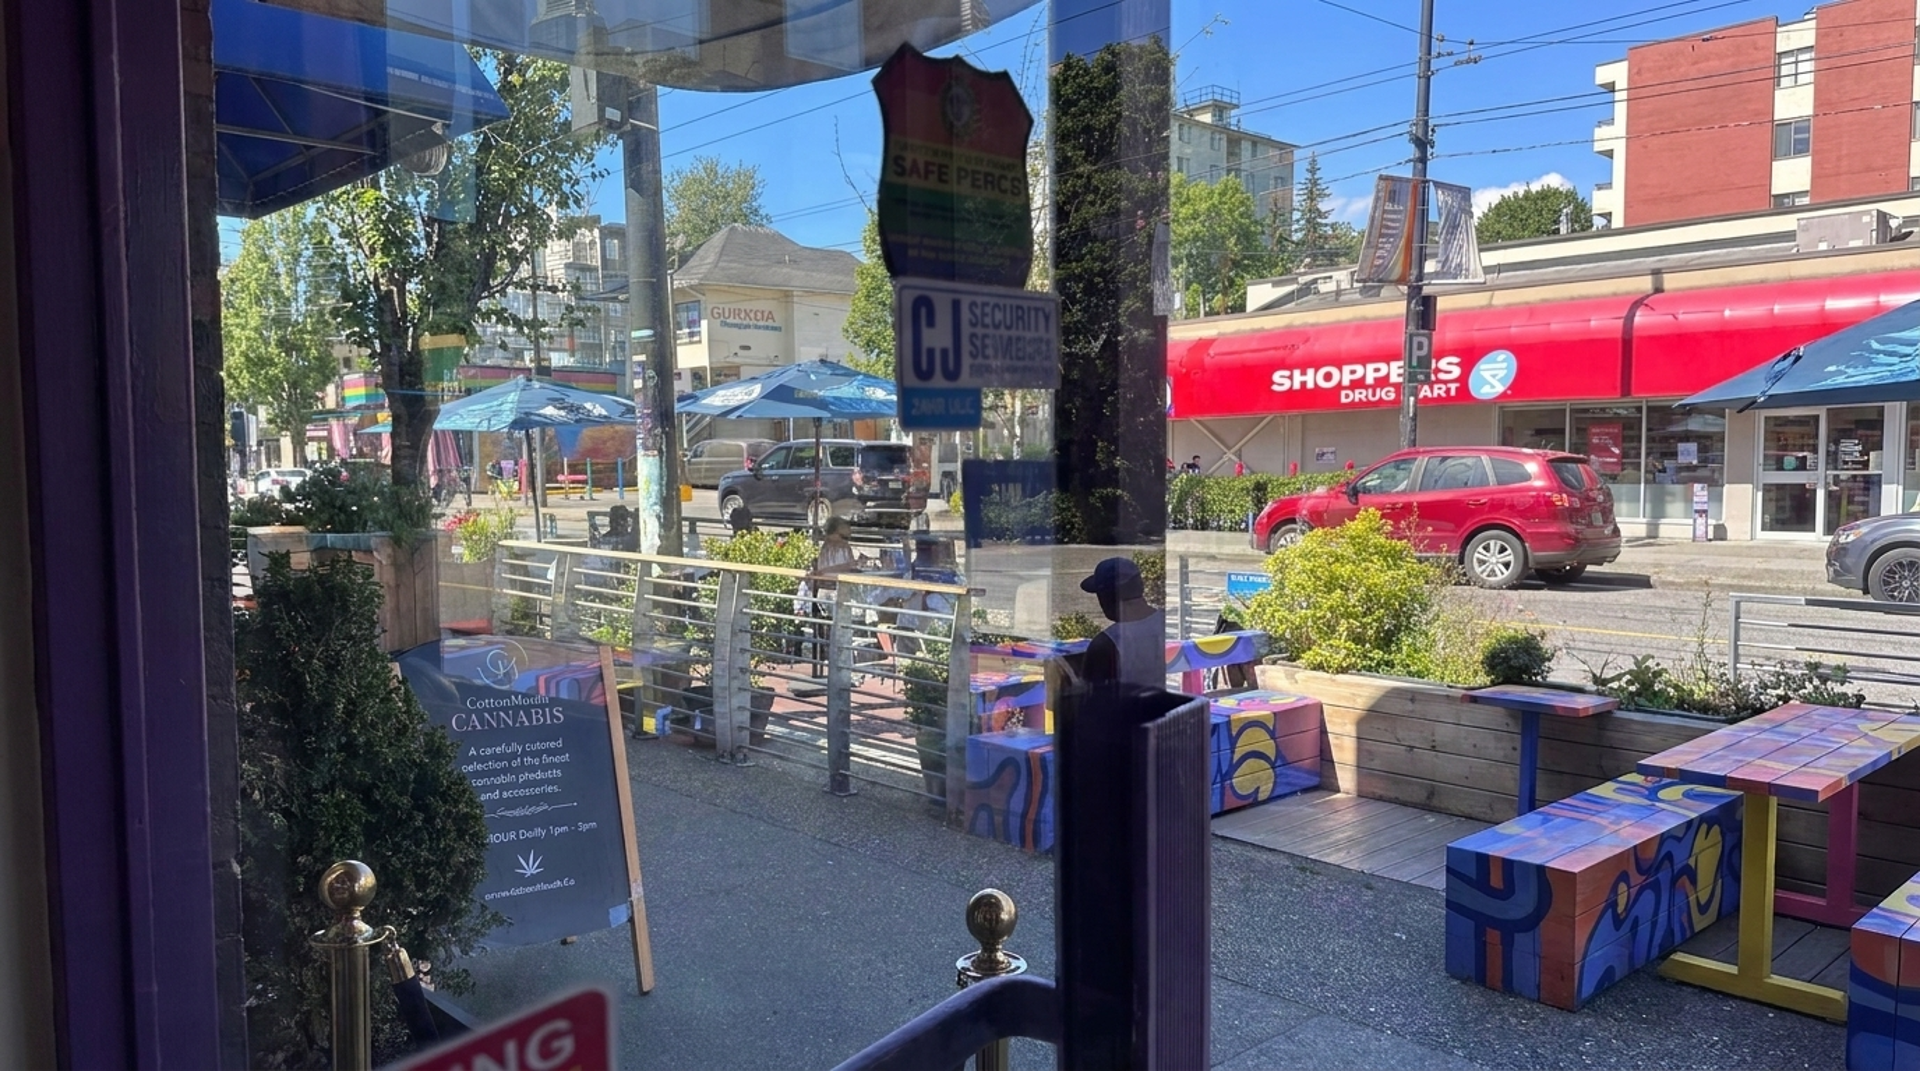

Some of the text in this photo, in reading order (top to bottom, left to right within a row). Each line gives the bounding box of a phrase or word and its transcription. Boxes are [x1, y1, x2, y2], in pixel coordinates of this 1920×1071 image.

[893, 154, 949, 184] SAFE
[968, 300, 1051, 333] SECURITY
[911, 294, 962, 382] CJ
[1412, 335, 1429, 367] P
[1340, 383, 1460, 404] DRUG ART
[452, 707, 565, 732] CANNABIS
[468, 747, 477, 756] A
[480, 742, 523, 755] carefully
[524, 756, 540, 766] the
[549, 825, 569, 836] 1pm
